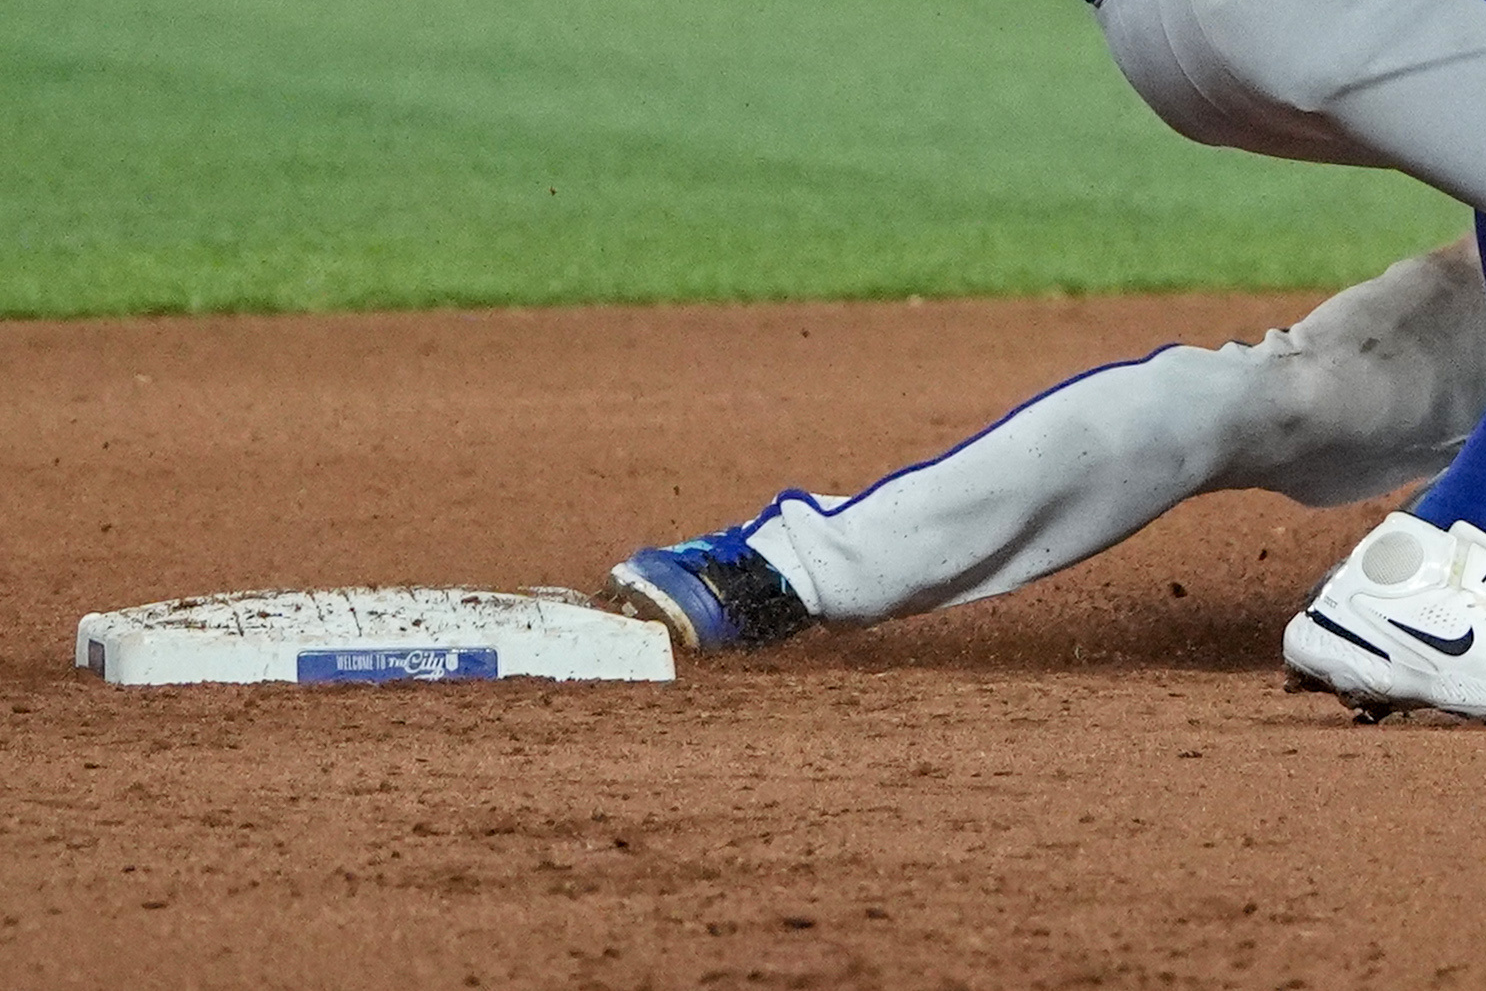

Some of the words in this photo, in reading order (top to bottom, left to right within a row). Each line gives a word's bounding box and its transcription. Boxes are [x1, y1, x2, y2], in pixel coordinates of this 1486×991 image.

[336, 654, 374, 671] WELCOME
[376, 654, 387, 670] TO
[405, 650, 446, 680] City
